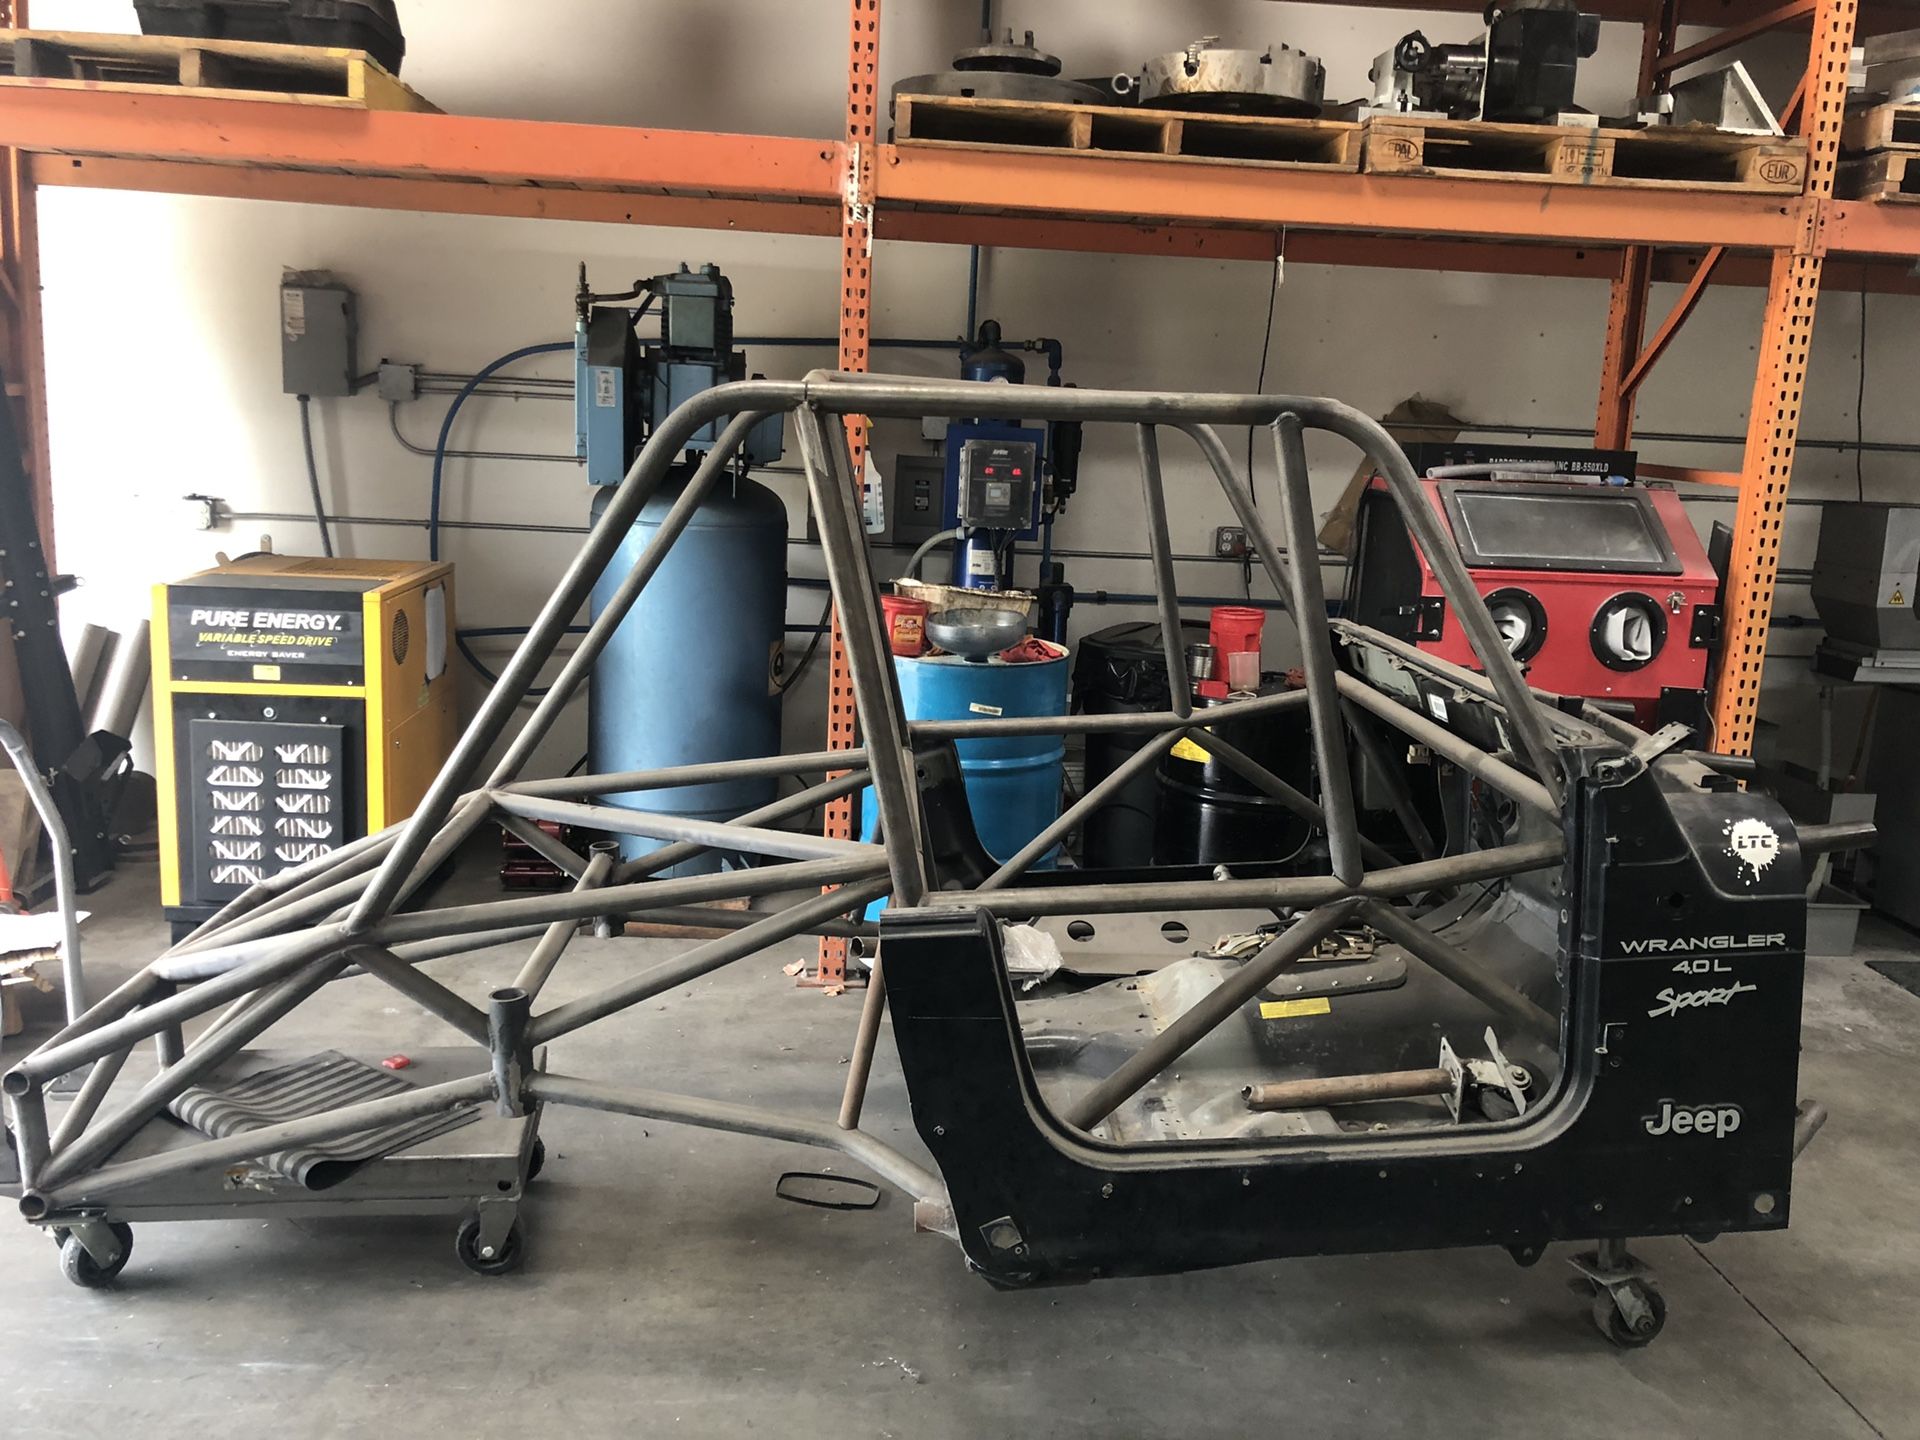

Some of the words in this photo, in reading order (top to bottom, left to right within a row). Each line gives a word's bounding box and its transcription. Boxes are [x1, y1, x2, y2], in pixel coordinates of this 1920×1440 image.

[1767, 163, 1790, 179] EUR
[190, 609, 249, 628] PURE
[253, 611, 341, 631] ENERGY
[199, 632, 256, 644] VARIABLE
[257, 634, 296, 646] SPEED
[296, 636, 333, 647] DRIVE
[227, 650, 268, 658] ENERGY
[271, 651, 305, 659] SAVER
[1738, 834, 1772, 849] LTC
[1620, 933, 1786, 954] WRANGLER
[1645, 1104, 1740, 1139] Jeep
